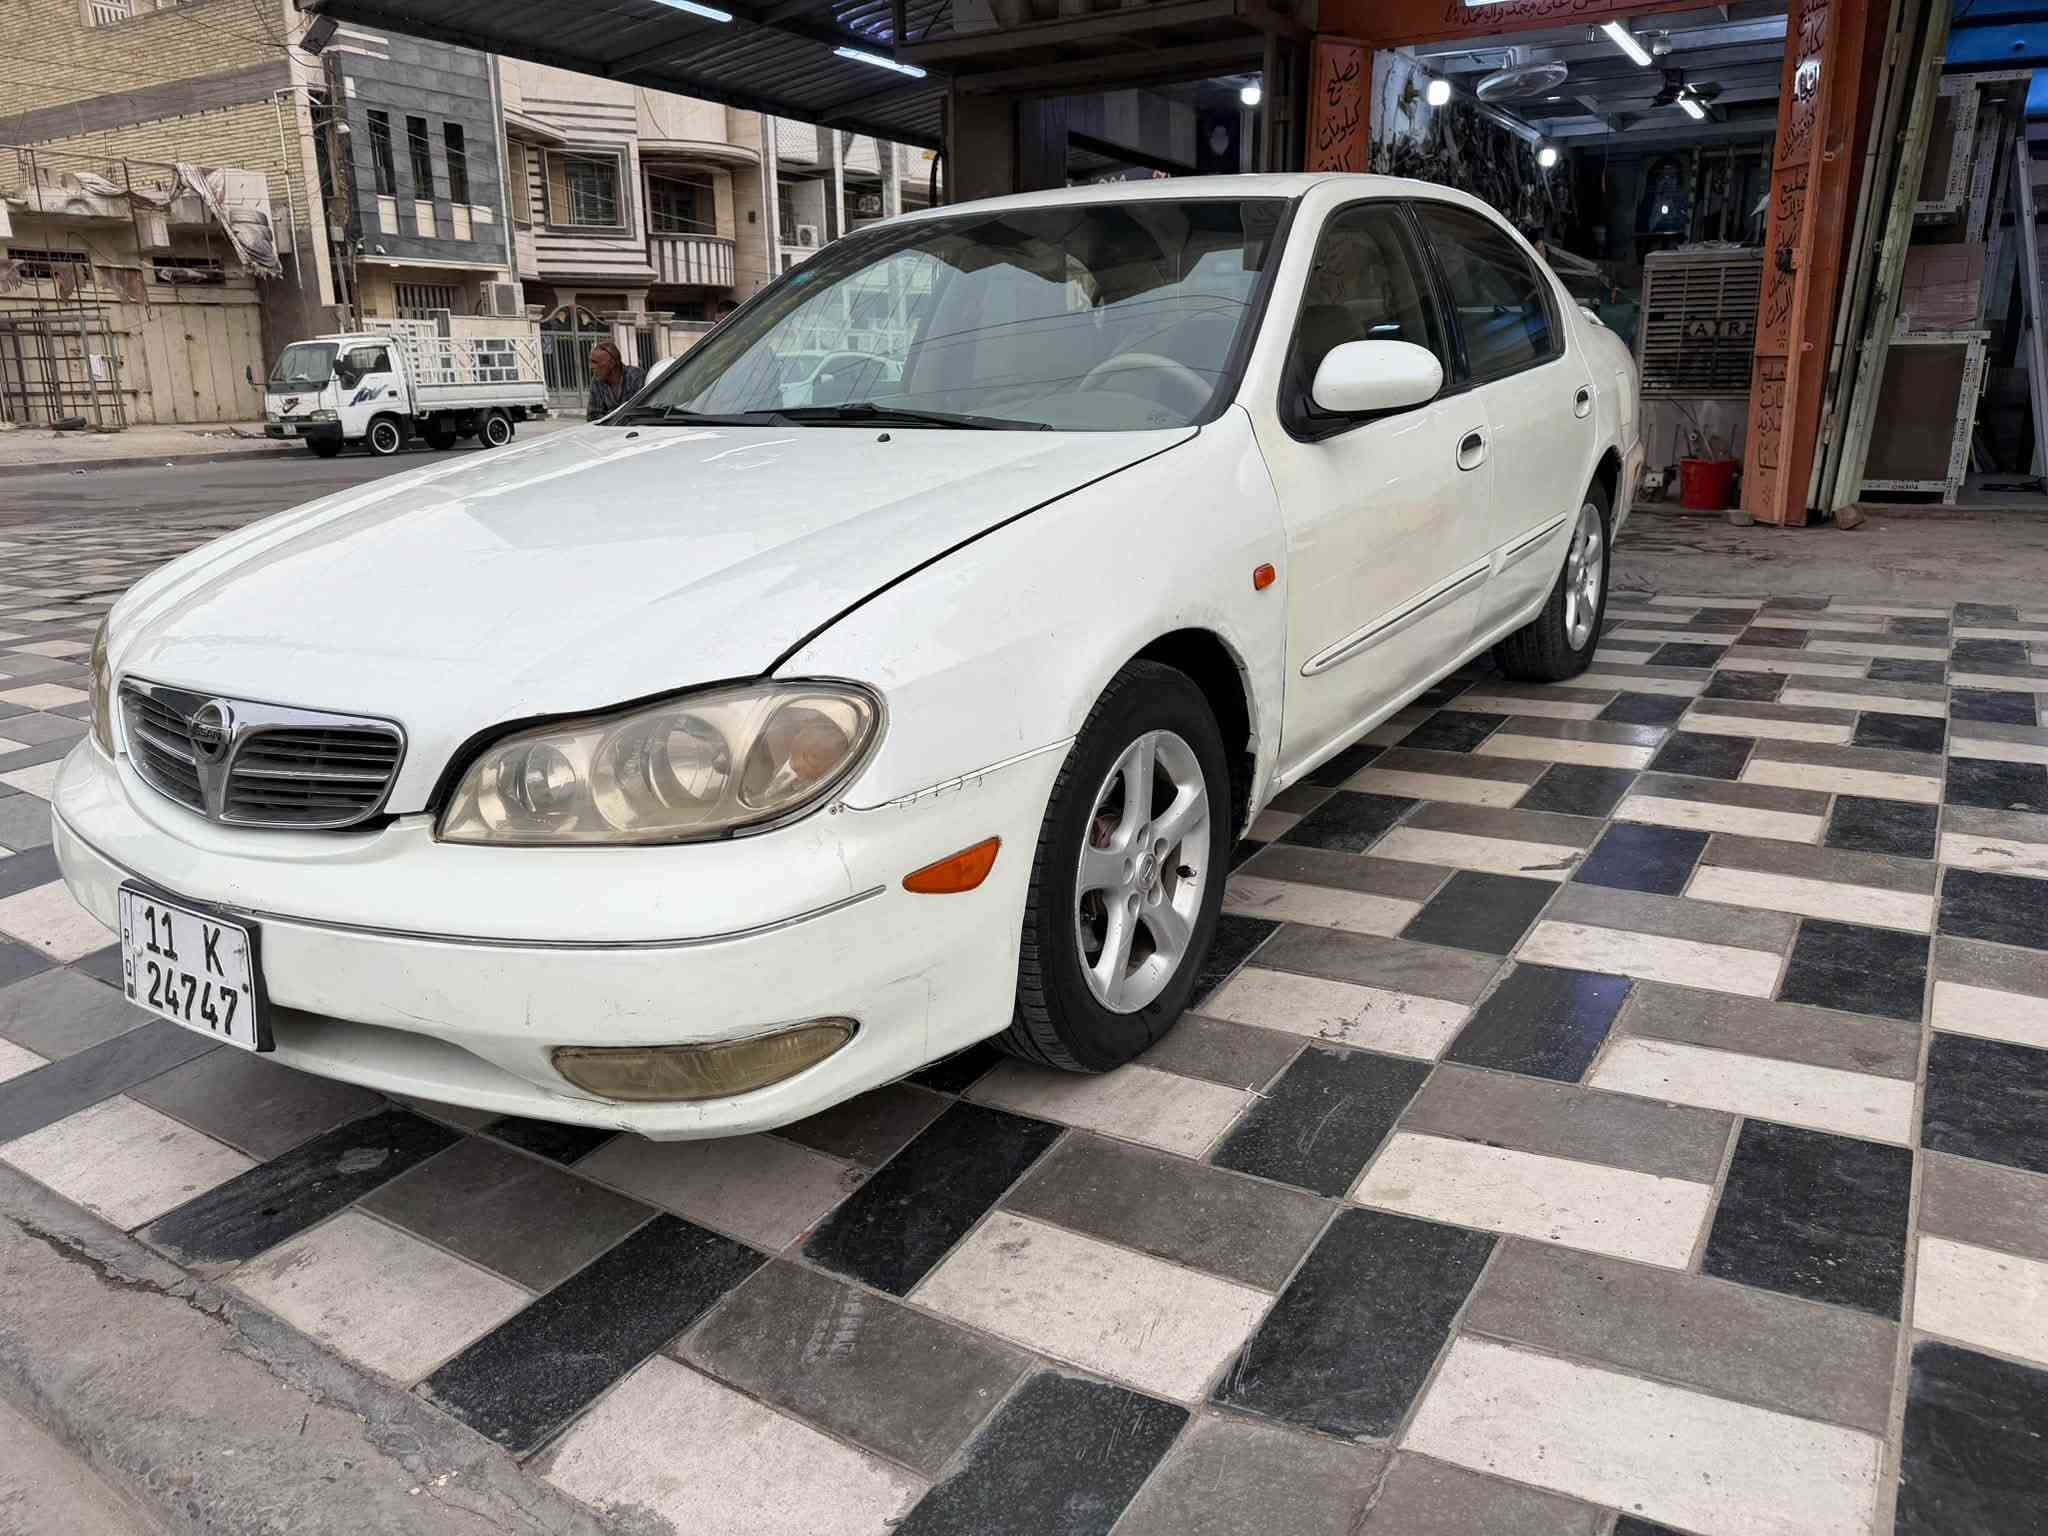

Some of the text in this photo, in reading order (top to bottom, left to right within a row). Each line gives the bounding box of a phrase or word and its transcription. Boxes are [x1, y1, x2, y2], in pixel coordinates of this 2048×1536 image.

[145, 905, 225, 977] 11 K
[147, 960, 238, 1035] 24747
